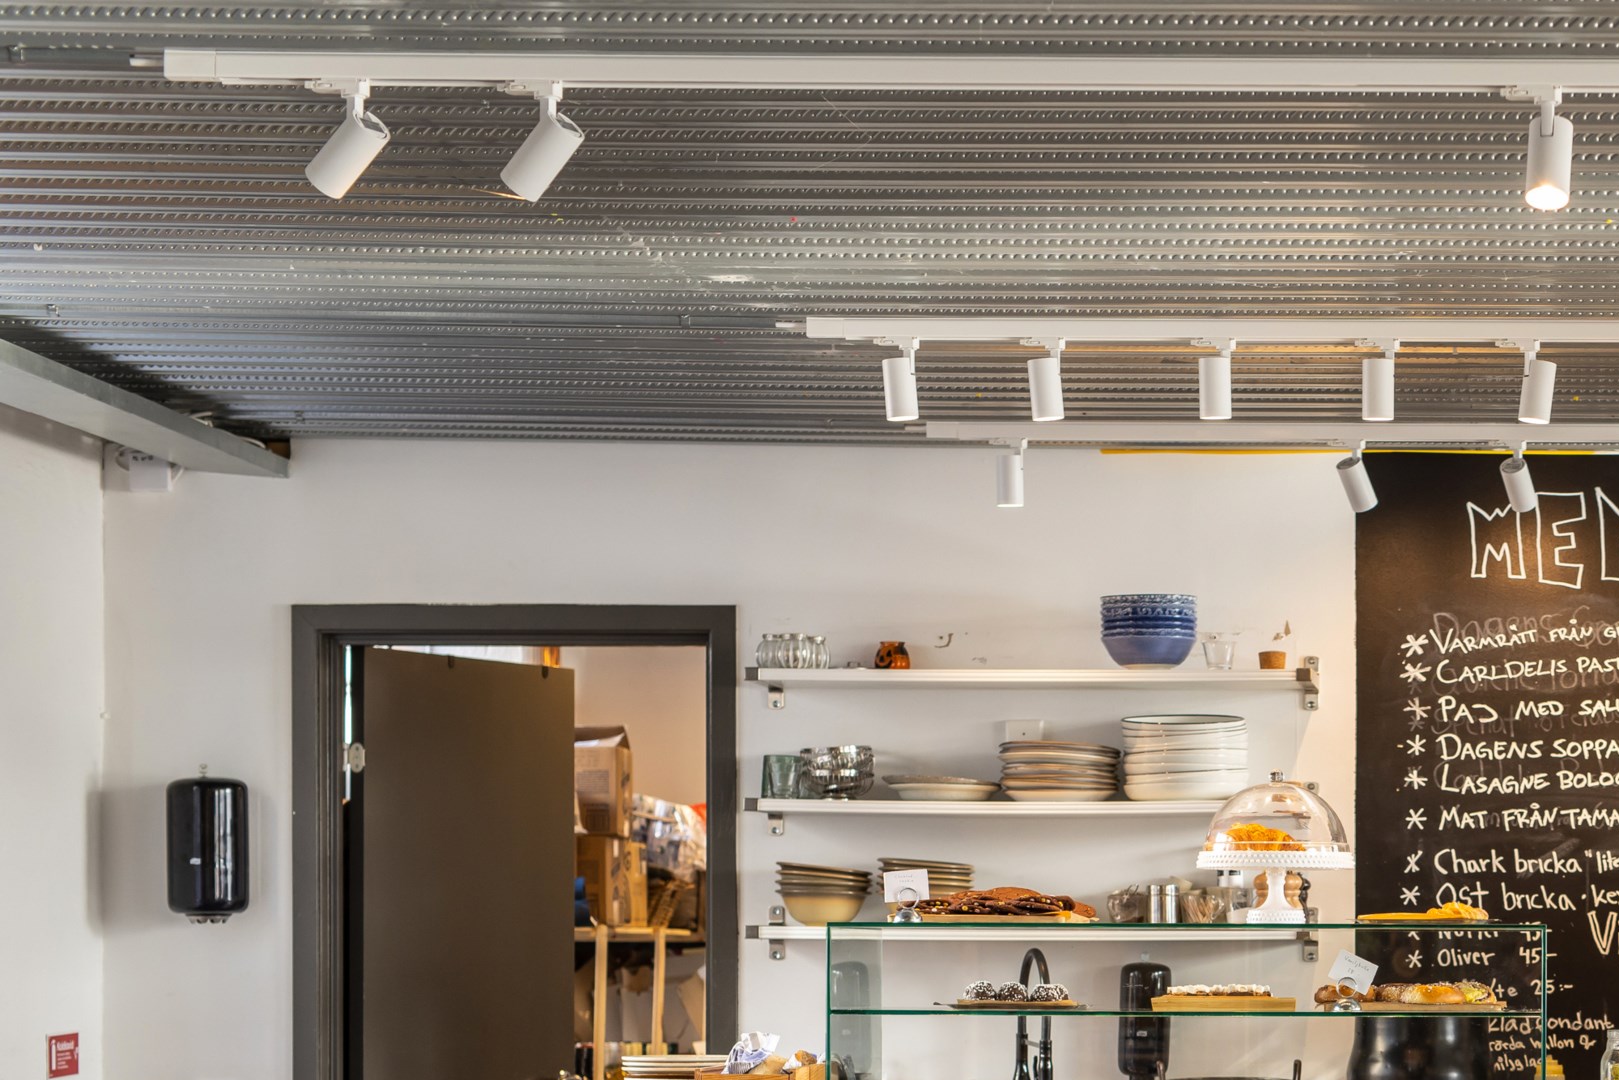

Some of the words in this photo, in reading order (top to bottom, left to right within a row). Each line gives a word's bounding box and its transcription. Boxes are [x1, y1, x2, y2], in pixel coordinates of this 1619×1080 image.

[1429, 624, 1538, 655] VARMRÄTT
[1549, 619, 1593, 642] FRÅN
[1436, 659, 1568, 684] CARLDELIS
[1515, 700, 1565, 721] MED
[1437, 733, 1543, 761] DAGENS
[1440, 764, 1551, 794] LASAGNE
[1439, 806, 1488, 831] MAT
[1502, 802, 1558, 831] FRÅN
[1433, 849, 1507, 875] Chark
[1513, 849, 1583, 875] bricka
[1435, 881, 1490, 909] Ost
[1500, 882, 1577, 911] bricka
[1437, 949, 1496, 968] Oliver
